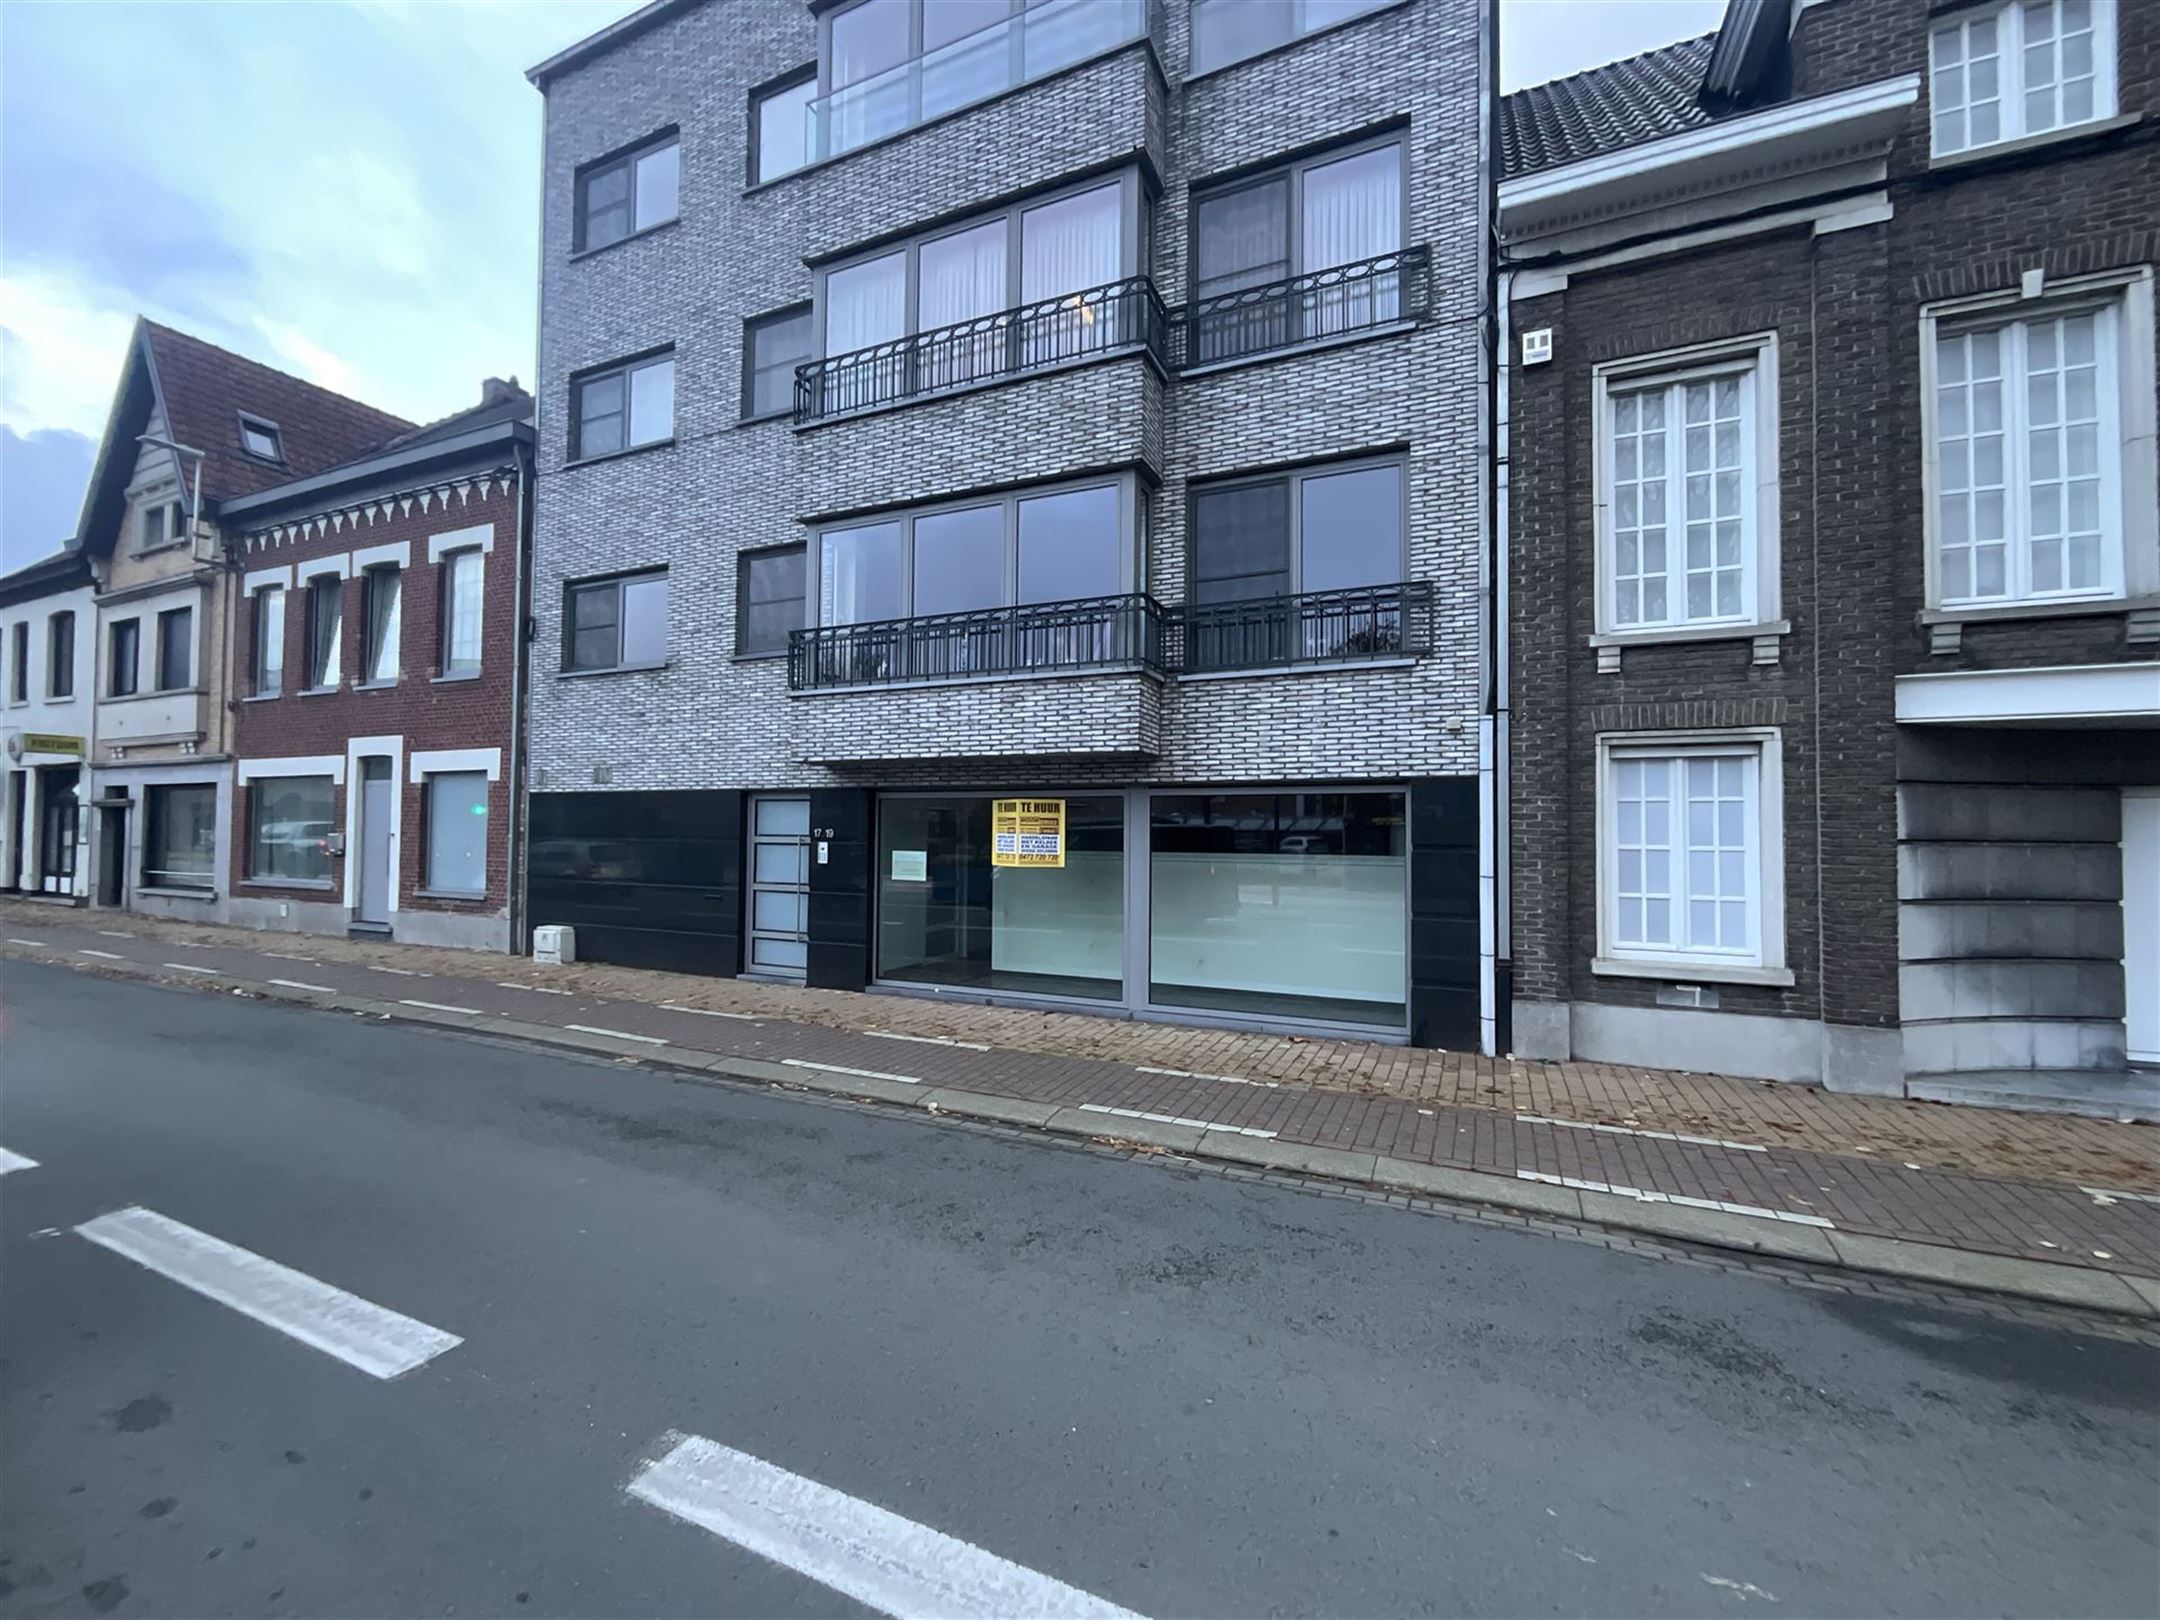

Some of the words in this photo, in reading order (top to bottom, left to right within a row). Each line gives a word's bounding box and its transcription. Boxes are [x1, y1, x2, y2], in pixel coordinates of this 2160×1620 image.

[1021, 802, 1031, 813] TE
[1034, 802, 1060, 813] HUUR
[814, 828, 822, 838] 17
[825, 828, 834, 838] 19
